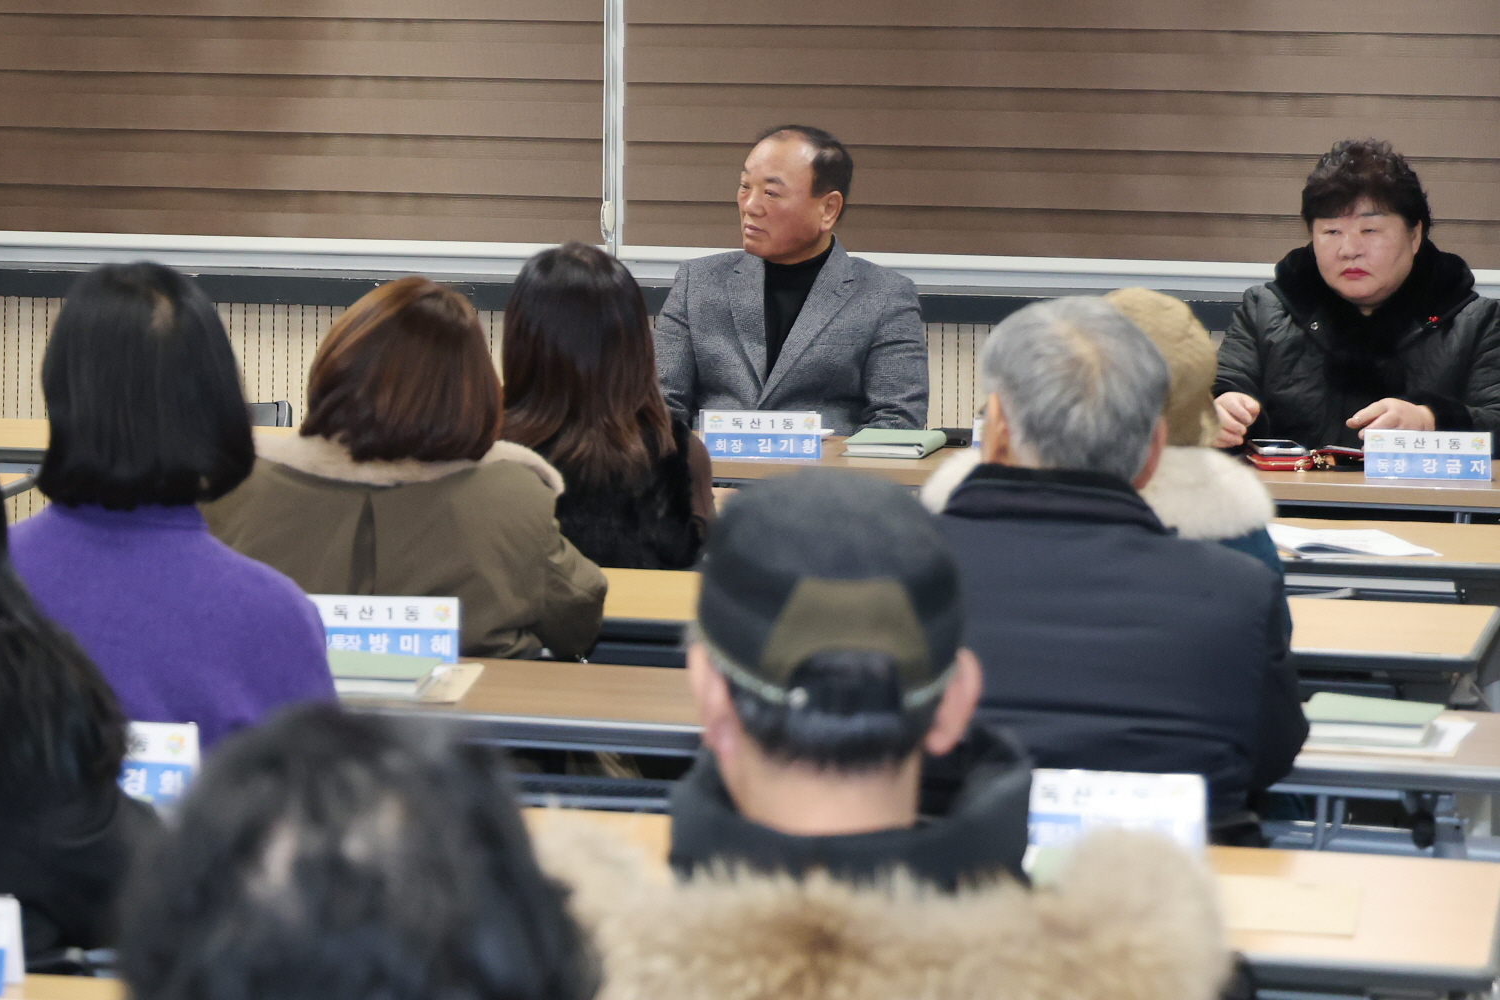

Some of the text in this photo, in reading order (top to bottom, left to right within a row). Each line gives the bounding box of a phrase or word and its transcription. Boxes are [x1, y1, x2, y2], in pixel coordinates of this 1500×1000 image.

[731, 417, 795, 430] 독산1동
[715, 437, 817, 455] 회장 김기황
[1393, 436, 1462, 450] 독산1동
[1376, 458, 1486, 475] 동장 강금자
[333, 604, 419, 622] 독산1동
[326, 632, 453, 656] 통장 방미혜
